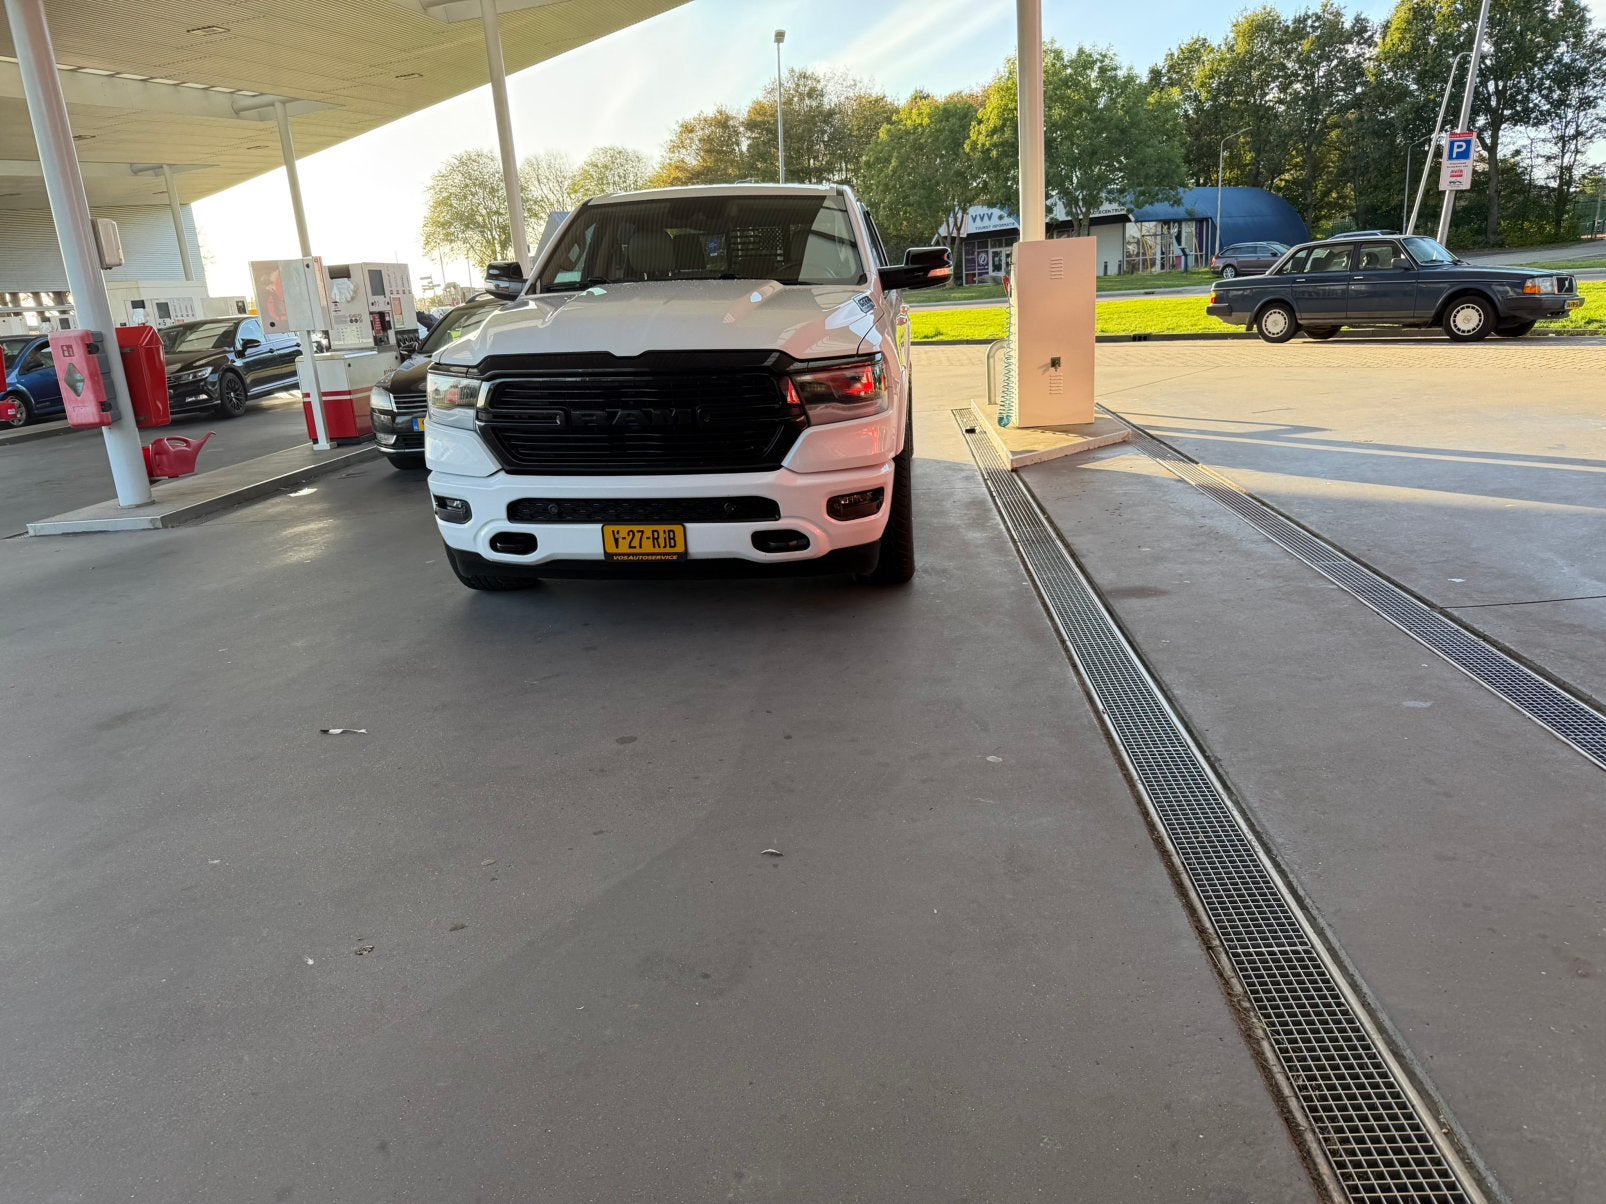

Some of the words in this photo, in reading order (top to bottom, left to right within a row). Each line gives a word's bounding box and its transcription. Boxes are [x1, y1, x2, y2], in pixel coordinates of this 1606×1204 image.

[1452, 141, 1467, 158] P
[971, 212, 993, 223] VVV
[569, 408, 692, 428] RAM
[611, 529, 677, 549] V-27-RJB
